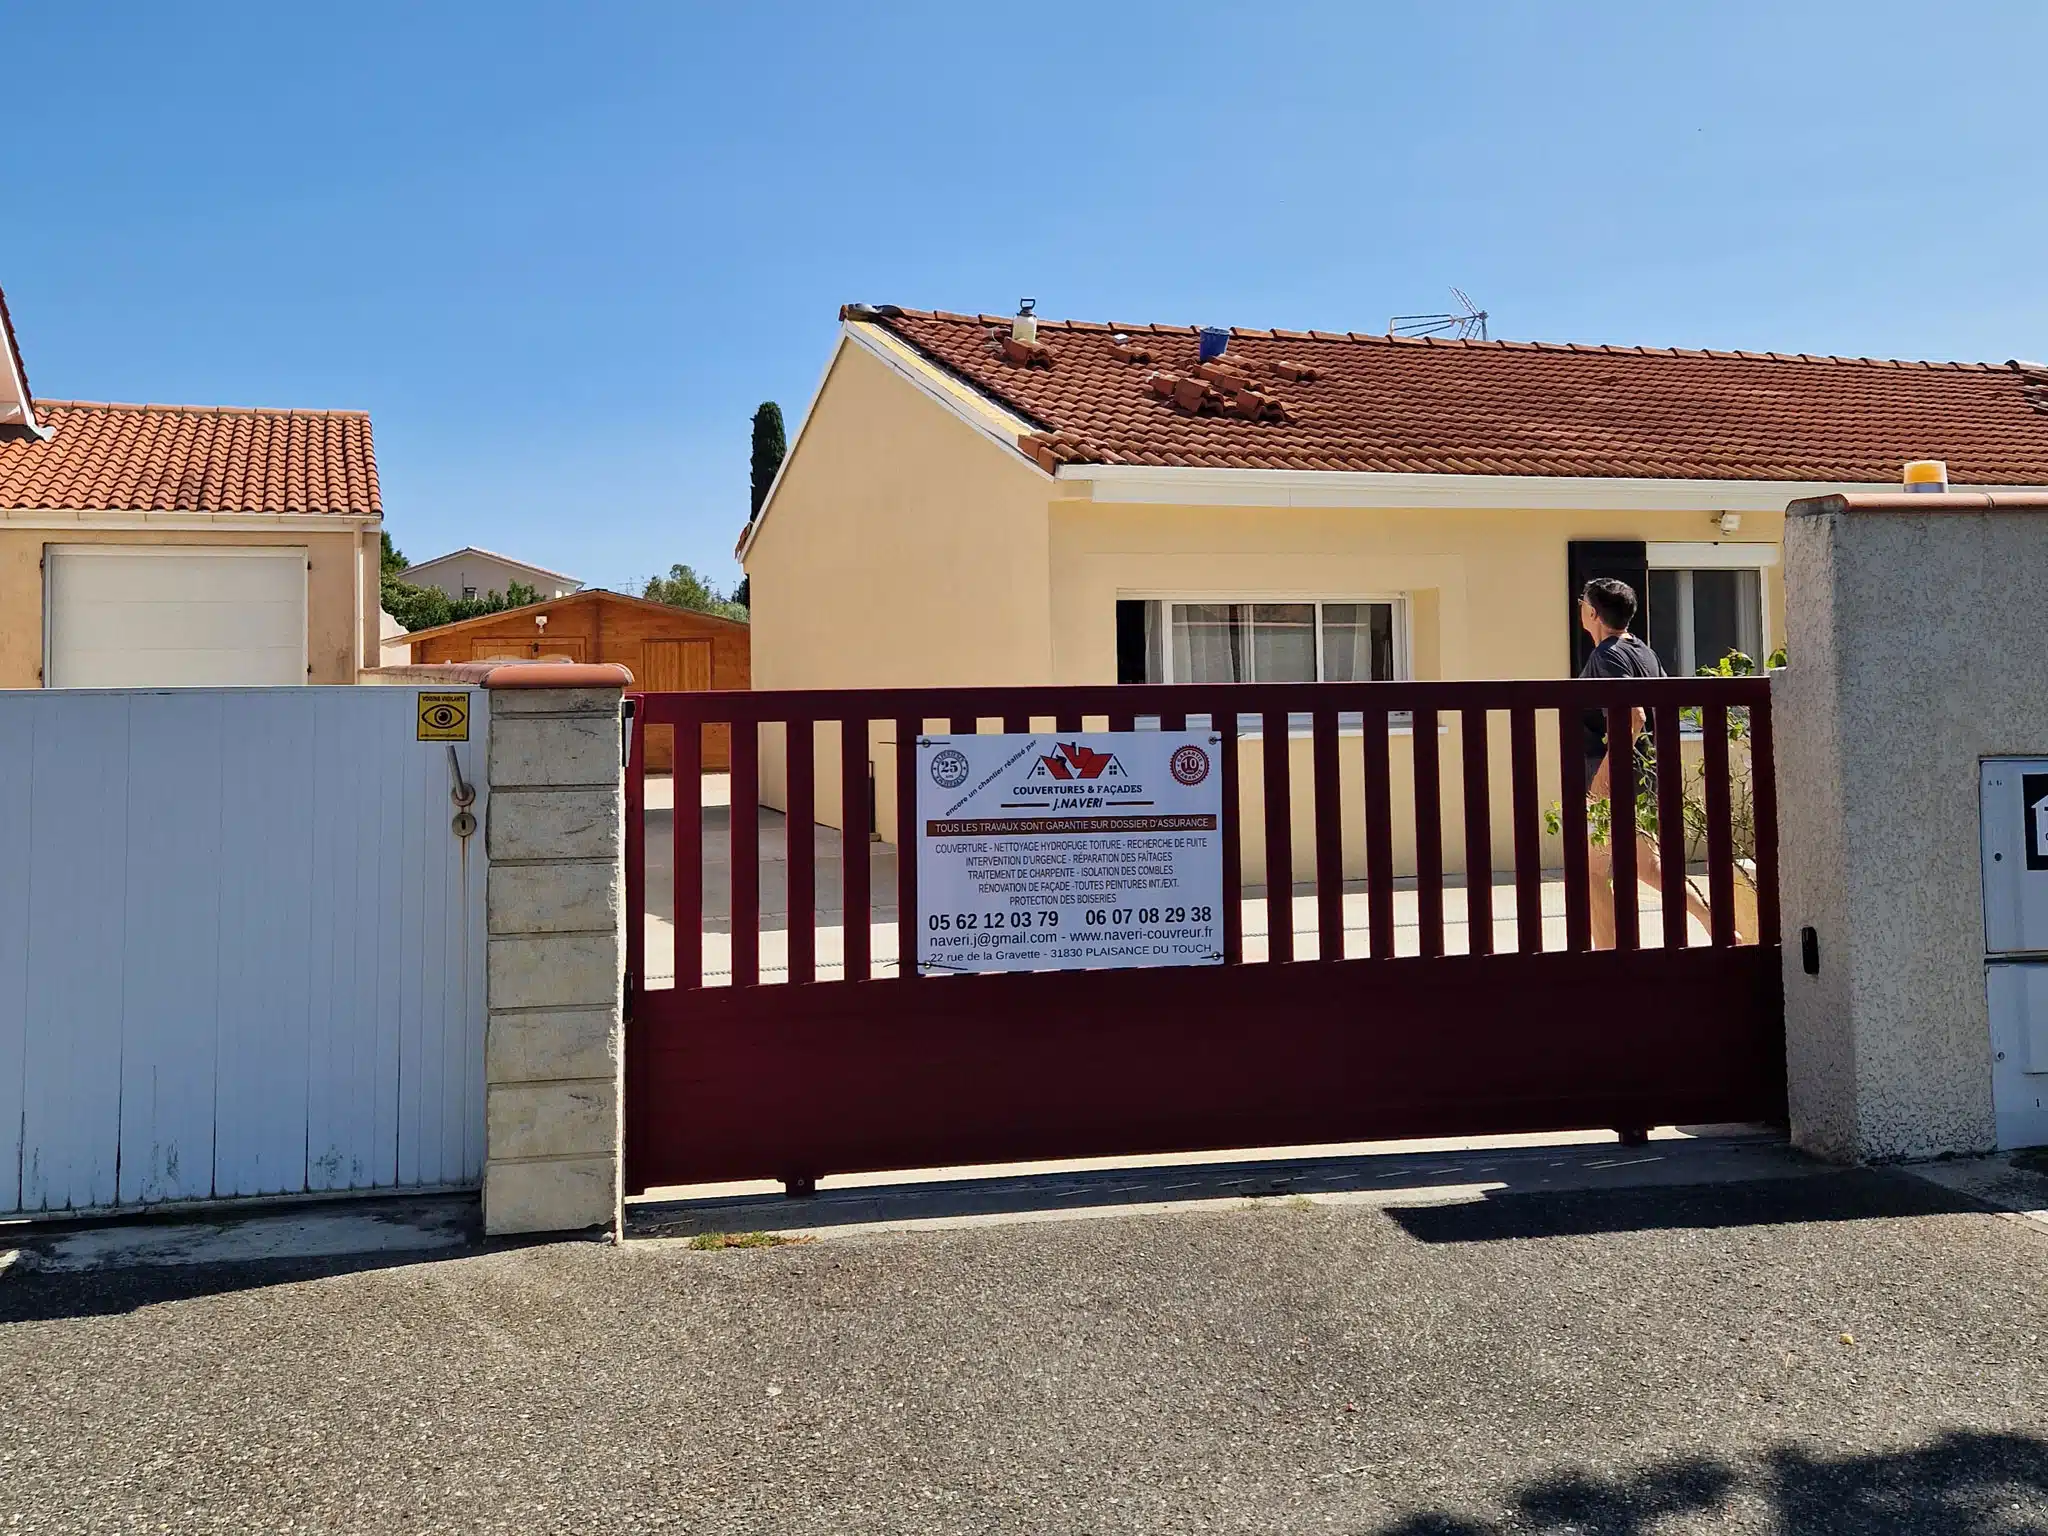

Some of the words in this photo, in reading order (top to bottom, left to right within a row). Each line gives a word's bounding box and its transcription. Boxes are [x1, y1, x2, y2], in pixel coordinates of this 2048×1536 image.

[940, 760, 958, 772] 25
[1182, 758, 1197, 769] 10
[946, 796, 968, 816] encore
[968, 788, 978, 798] un
[978, 767, 1004, 790] chantier
[1004, 748, 1026, 768] réalisé
[1026, 740, 1037, 752] par
[1013, 786, 1085, 795] COUVERTURES
[1088, 786, 1095, 794] &
[1097, 785, 1142, 796] FAÇADES
[936, 824, 959, 832] TOUS
[962, 823, 977, 832] LES
[980, 822, 1018, 832] TRAVAUX
[1020, 822, 1044, 831] SONT
[1046, 820, 1088, 830] GARANTIE
[1090, 820, 1108, 829] SUR
[1111, 819, 1148, 828] DOSSIER
[1150, 818, 1208, 828] D'ASSURANCE
[936, 843, 988, 853] COUVERTURE
[994, 842, 1039, 852] NETTOYAGE
[1041, 841, 1087, 851] HYDROFUGE
[1089, 840, 1121, 849] TOITURE
[1128, 838, 1172, 848] RECHERCHE
[1175, 838, 1185, 848] DE
[1187, 838, 1207, 848] FUITE
[966, 856, 1021, 866] INTERVENTION
[1023, 855, 1066, 865] D'URGENCE
[1073, 852, 1119, 863] RÉPARATION
[1121, 853, 1136, 863] DES
[968, 870, 1015, 880] TRAITEMENT
[1018, 869, 1027, 878] DE
[1030, 868, 1075, 878] CHARPENTE
[1081, 867, 1120, 876] ISOLATION
[1121, 866, 1136, 876] DES
[1138, 865, 1173, 875] COMBLES
[979, 882, 1026, 893] RÉNOVATION
[1029, 882, 1038, 892] DE
[1041, 882, 1070, 893] FAÇADE
[1106, 879, 1147, 889] PEINTURES
[1010, 895, 1058, 905] PROTECTION
[1060, 895, 1076, 904] DES
[1077, 894, 1116, 903] BOISERIES
[929, 915, 950, 930] 05
[956, 914, 977, 929] 62
[984, 913, 1004, 928] 12
[1010, 912, 1032, 928] 03
[1038, 911, 1058, 926] 79
[1085, 909, 1106, 925] 06
[1112, 909, 1133, 924] 07
[1138, 908, 1160, 924] 08
[1165, 907, 1186, 923] 29
[1191, 906, 1212, 922] 38
[930, 932, 1057, 948] naveri.j@gmail.com
[1070, 926, 1213, 942] www.naveri-couvreur.fr
[930, 953, 944, 962] 22
[947, 953, 963, 962] rue
[967, 951, 980, 961] de
[984, 951, 992, 960] la
[995, 950, 1040, 960] Gravette
[1050, 948, 1082, 958] 31830
[1085, 946, 1150, 956] PLAISANCE
[1152, 945, 1169, 954] DU
[1172, 944, 1212, 953] TOUCH
